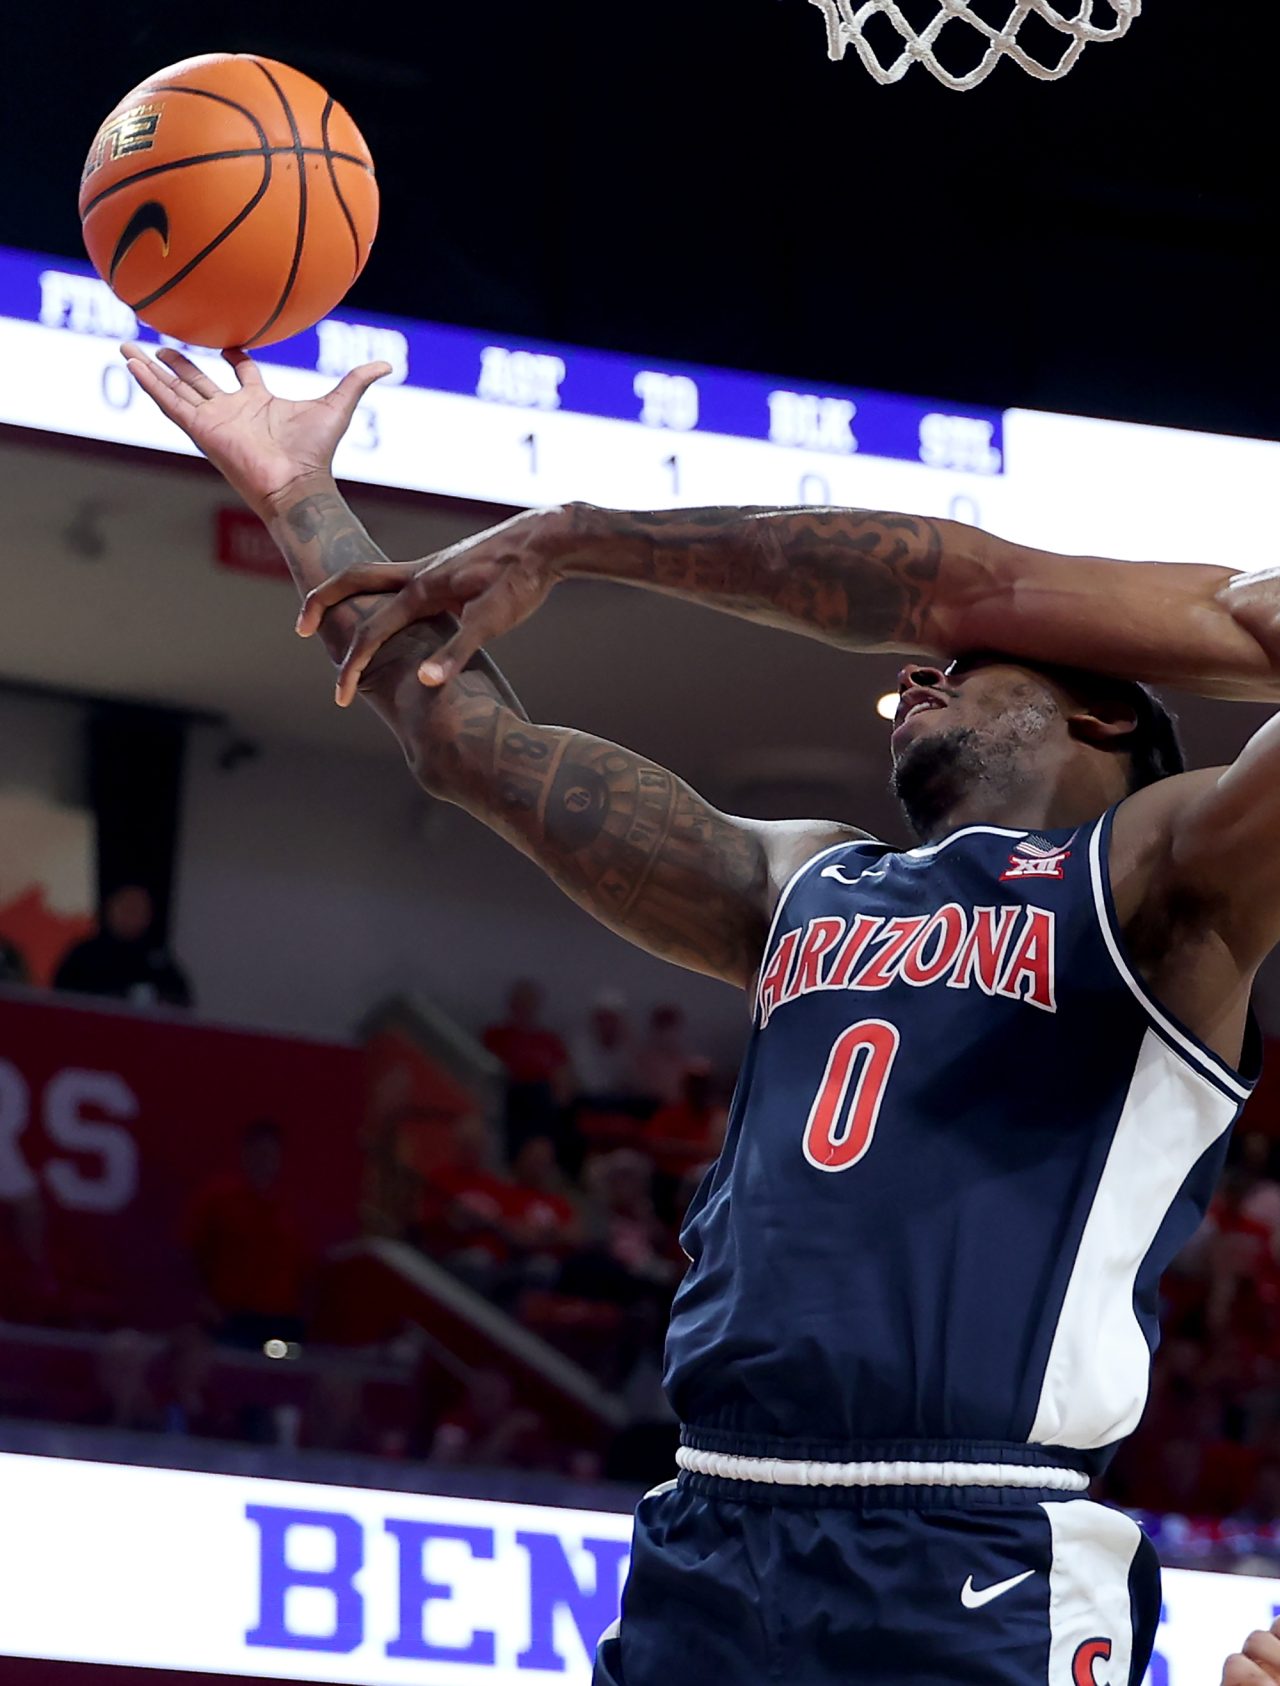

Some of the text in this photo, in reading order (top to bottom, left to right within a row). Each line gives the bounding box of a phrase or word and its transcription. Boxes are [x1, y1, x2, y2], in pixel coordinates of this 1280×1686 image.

[102, 364, 132, 409] 0
[521, 432, 538, 475] 1
[660, 455, 680, 495] 1
[633, 370, 698, 431] TO
[759, 902, 1057, 1030] ARIZONA
[802, 1018, 900, 1173] 0
